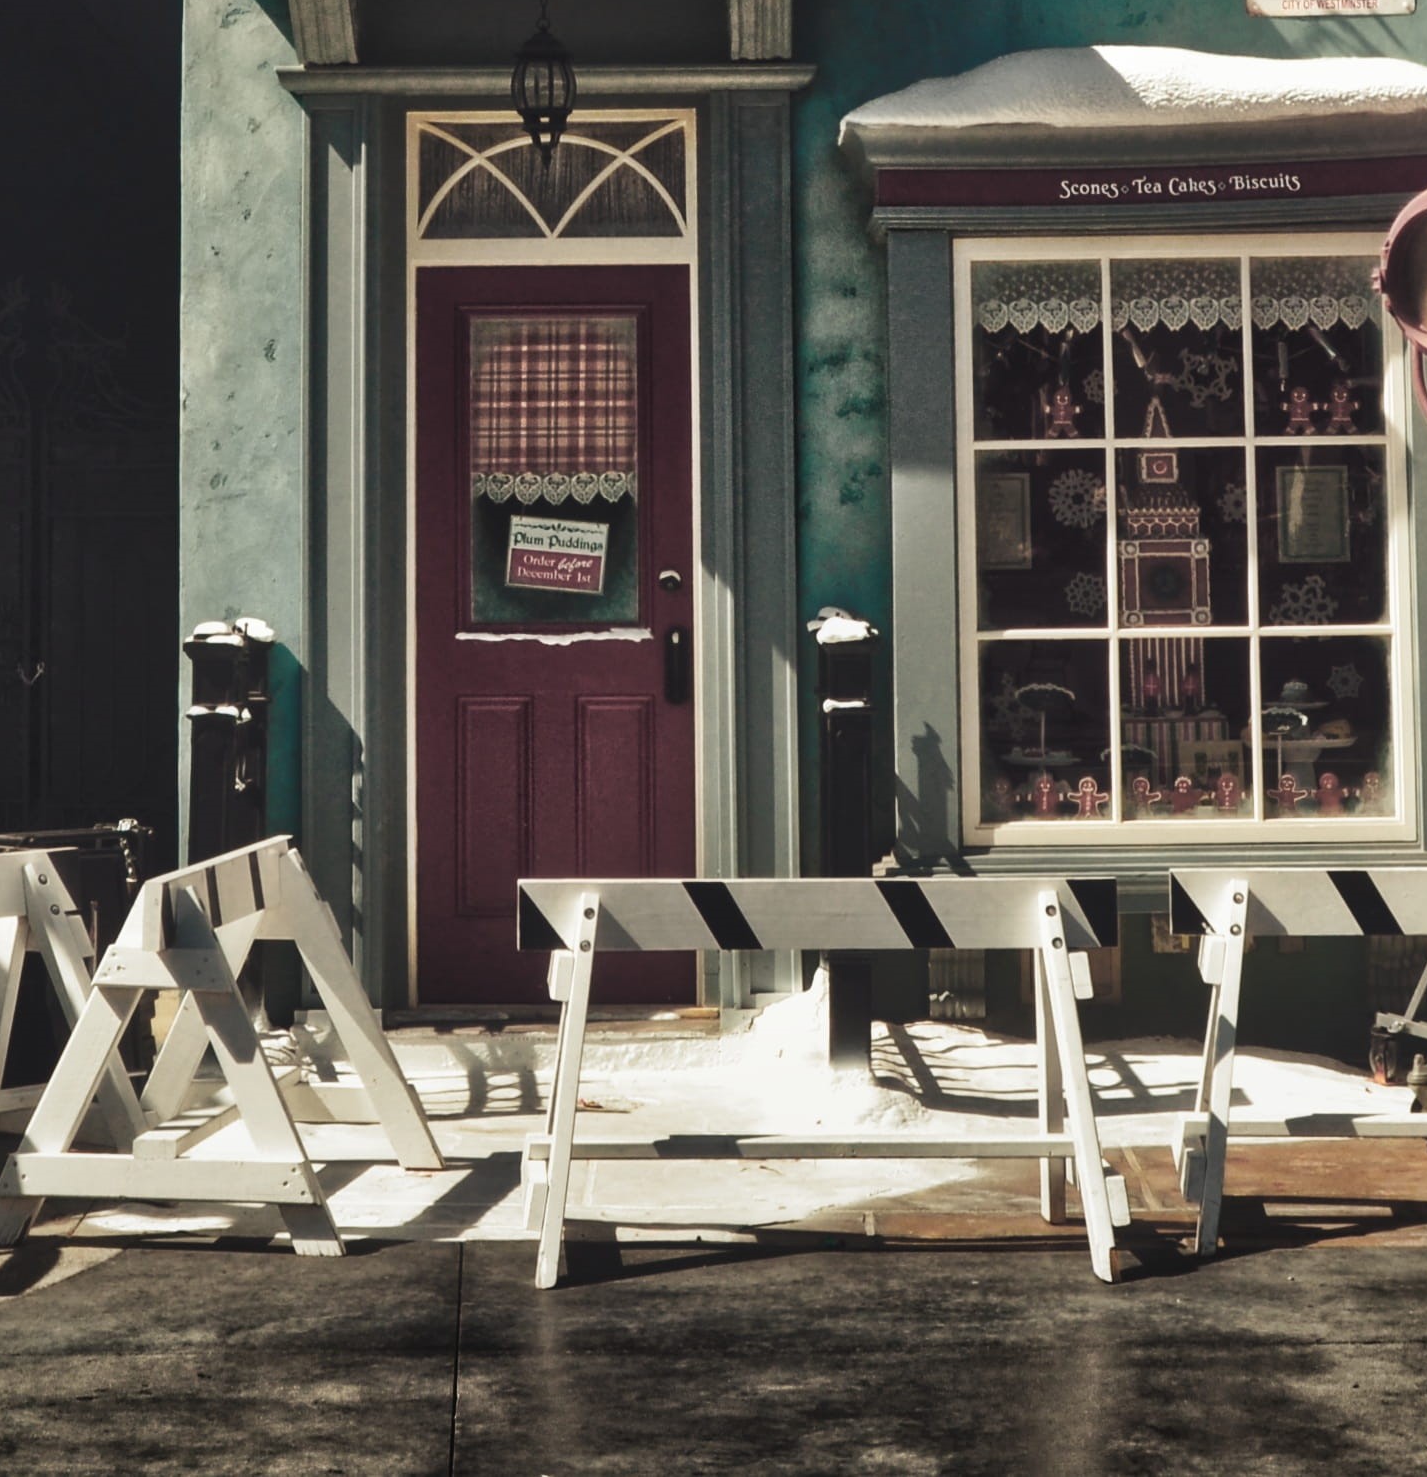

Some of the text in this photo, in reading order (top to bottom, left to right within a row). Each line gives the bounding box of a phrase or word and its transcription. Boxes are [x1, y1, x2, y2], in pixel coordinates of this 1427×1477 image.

[1282, 0, 1300, 10] CITY
[1303, 0, 1316, 10] OF
[1060, 173, 1301, 199] Scones Tea Cakes Biscuits
[514, 531, 604, 553] Plum Puddings
[523, 554, 593, 573] Order before
[517, 566, 572, 582] December
